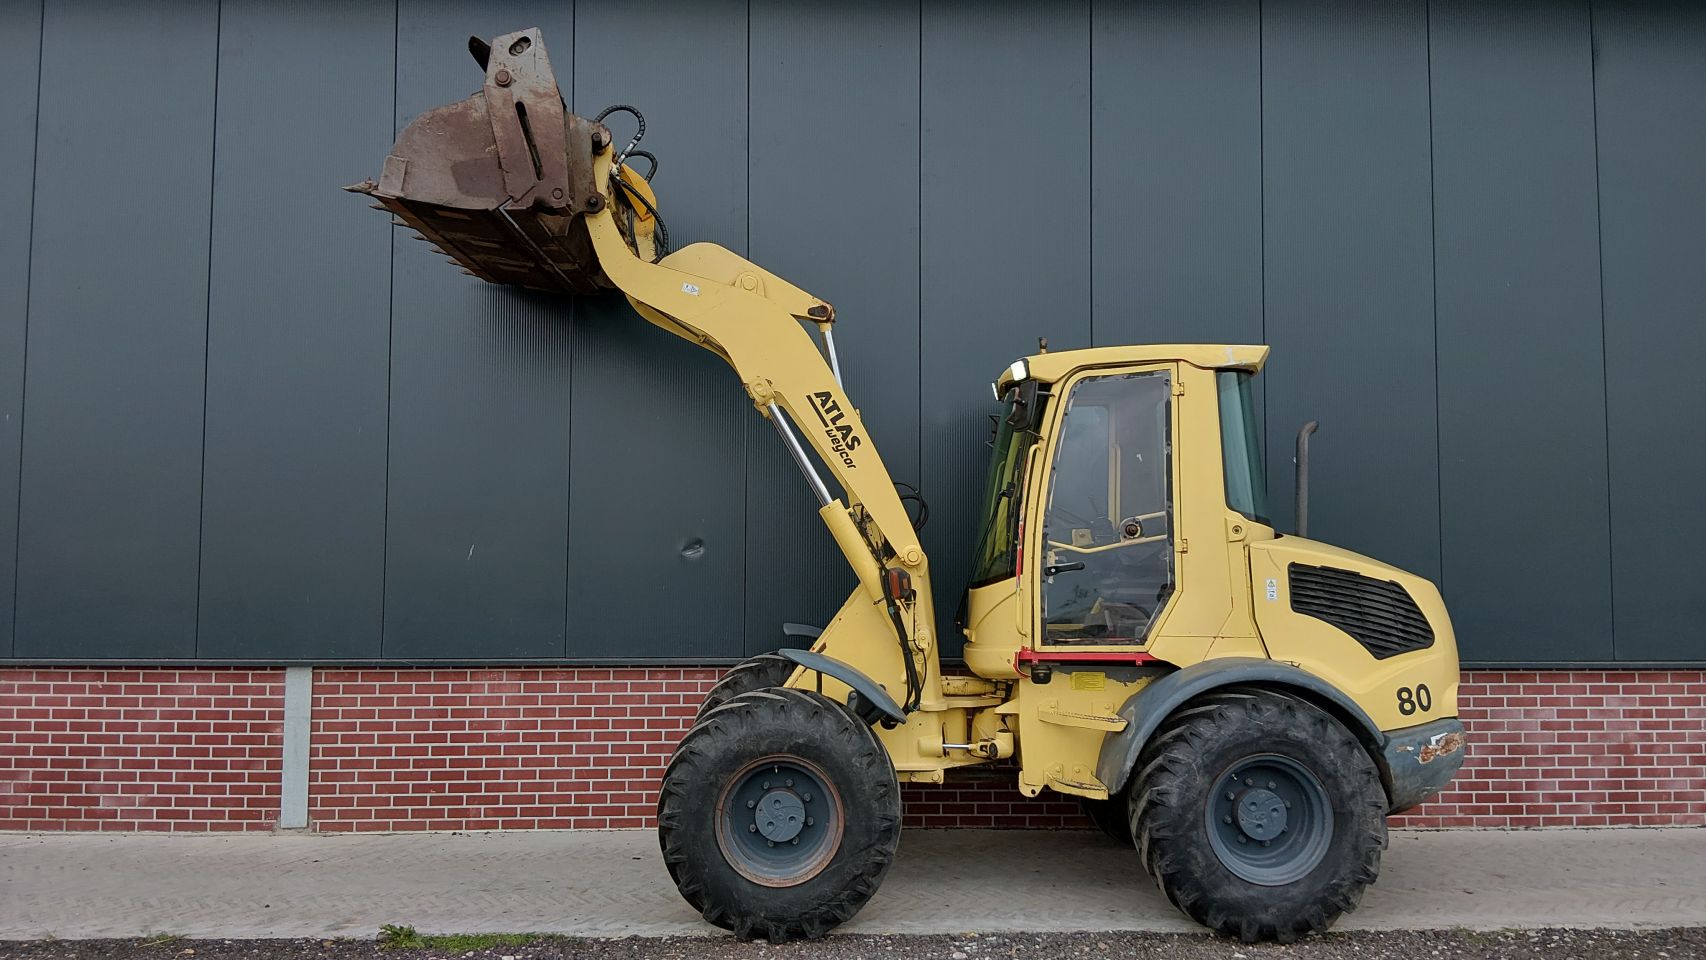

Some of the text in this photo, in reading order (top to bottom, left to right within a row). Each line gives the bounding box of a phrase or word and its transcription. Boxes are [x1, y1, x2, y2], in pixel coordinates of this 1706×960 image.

[814, 391, 861, 451] ATLAS
[825, 429, 856, 468] weycor
[1396, 683, 1432, 716] 80
